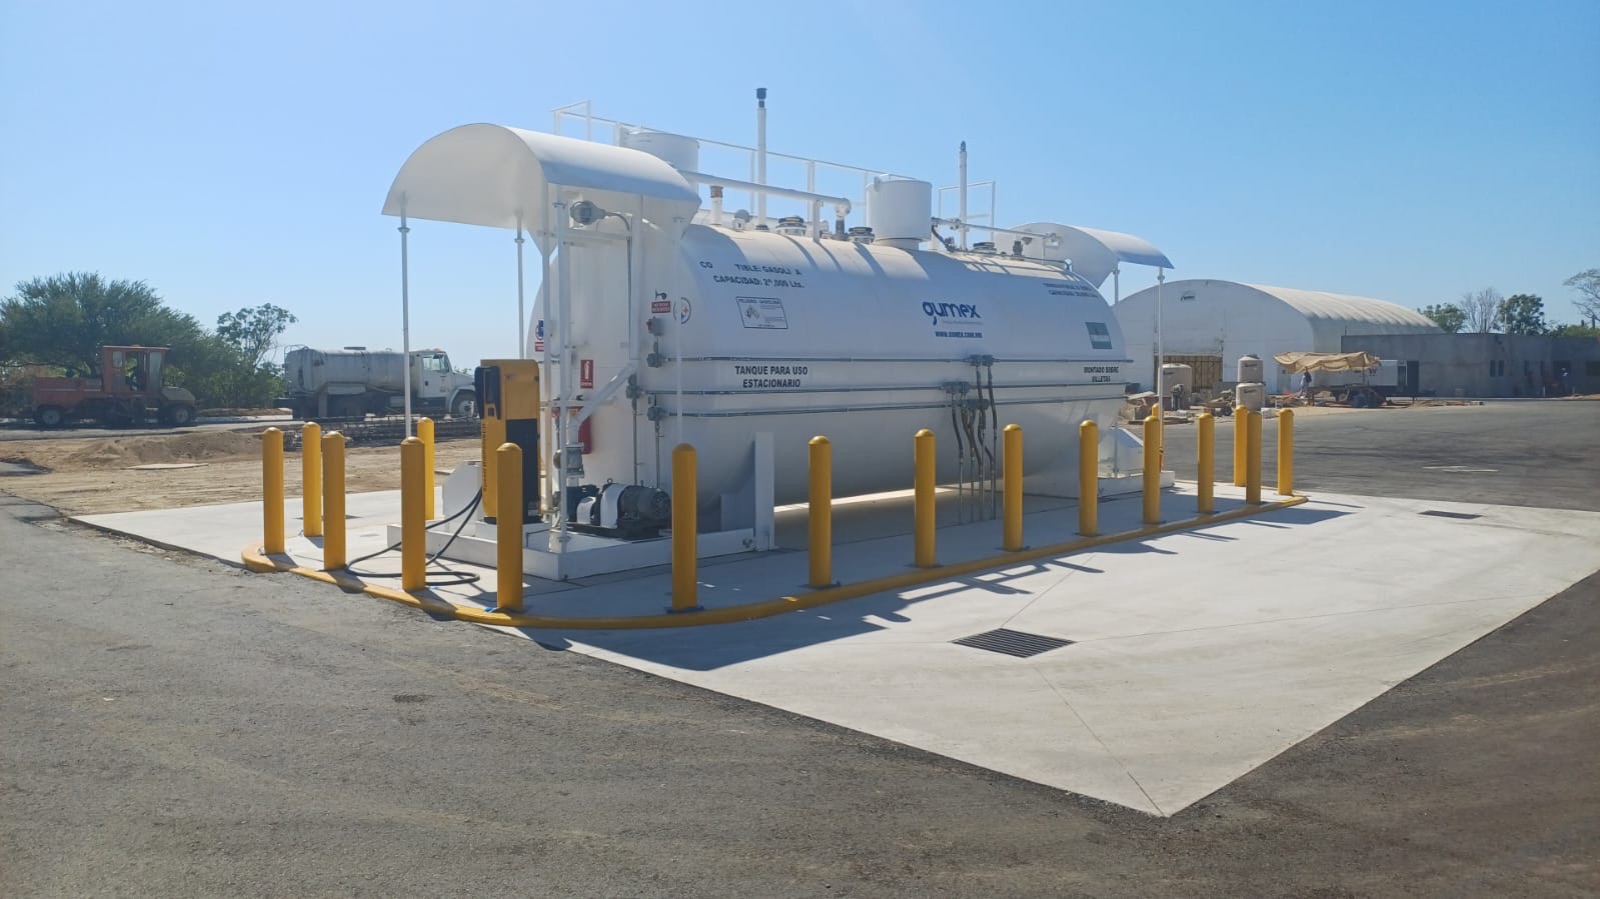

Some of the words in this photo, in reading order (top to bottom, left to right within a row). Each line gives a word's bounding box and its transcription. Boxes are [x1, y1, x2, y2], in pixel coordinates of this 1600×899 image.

[762, 265, 803, 275] GASOLIA
[734, 366, 768, 375] TANQUE
[770, 366, 791, 375] PARA
[792, 366, 808, 375] USO
[742, 379, 800, 388] ESTACIONARIO
